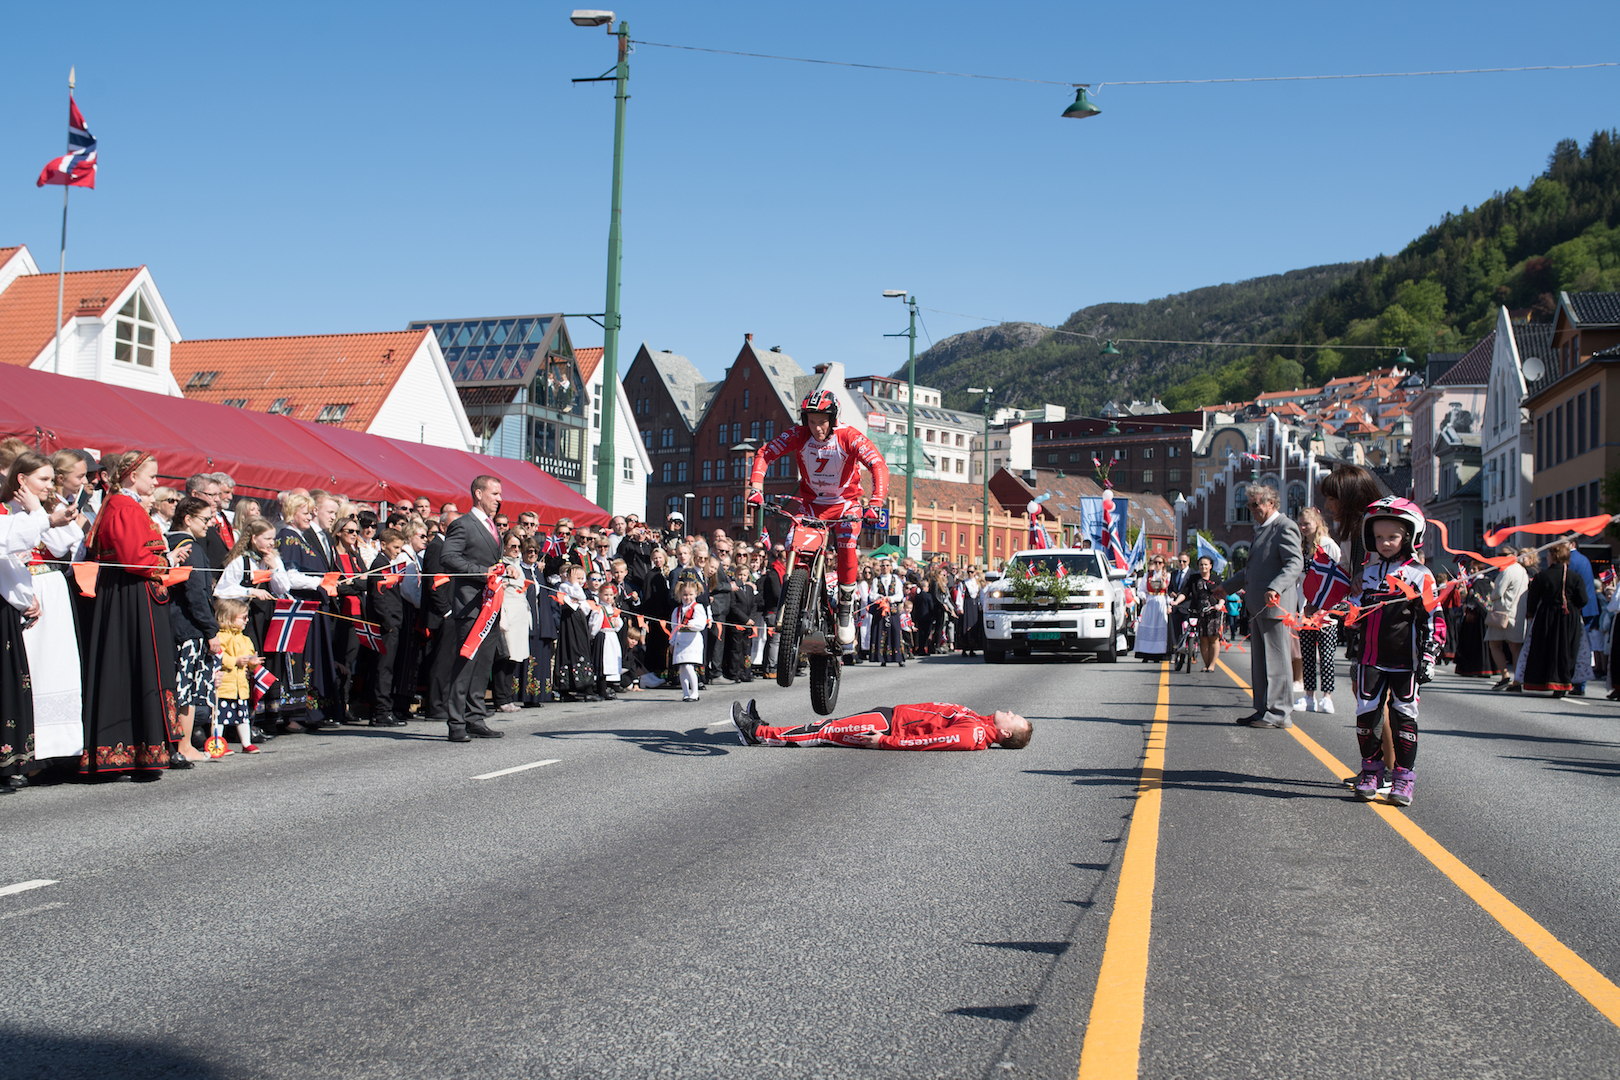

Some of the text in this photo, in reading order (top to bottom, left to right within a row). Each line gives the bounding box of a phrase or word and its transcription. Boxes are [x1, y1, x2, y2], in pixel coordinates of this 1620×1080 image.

[536, 455, 581, 471] RESTAURANT
[815, 457, 829, 473] 7
[540, 465, 576, 477] BRYGGERI
[802, 533, 818, 546] 7
[824, 723, 875, 734] Montesa
[900, 734, 960, 747] Montesa
